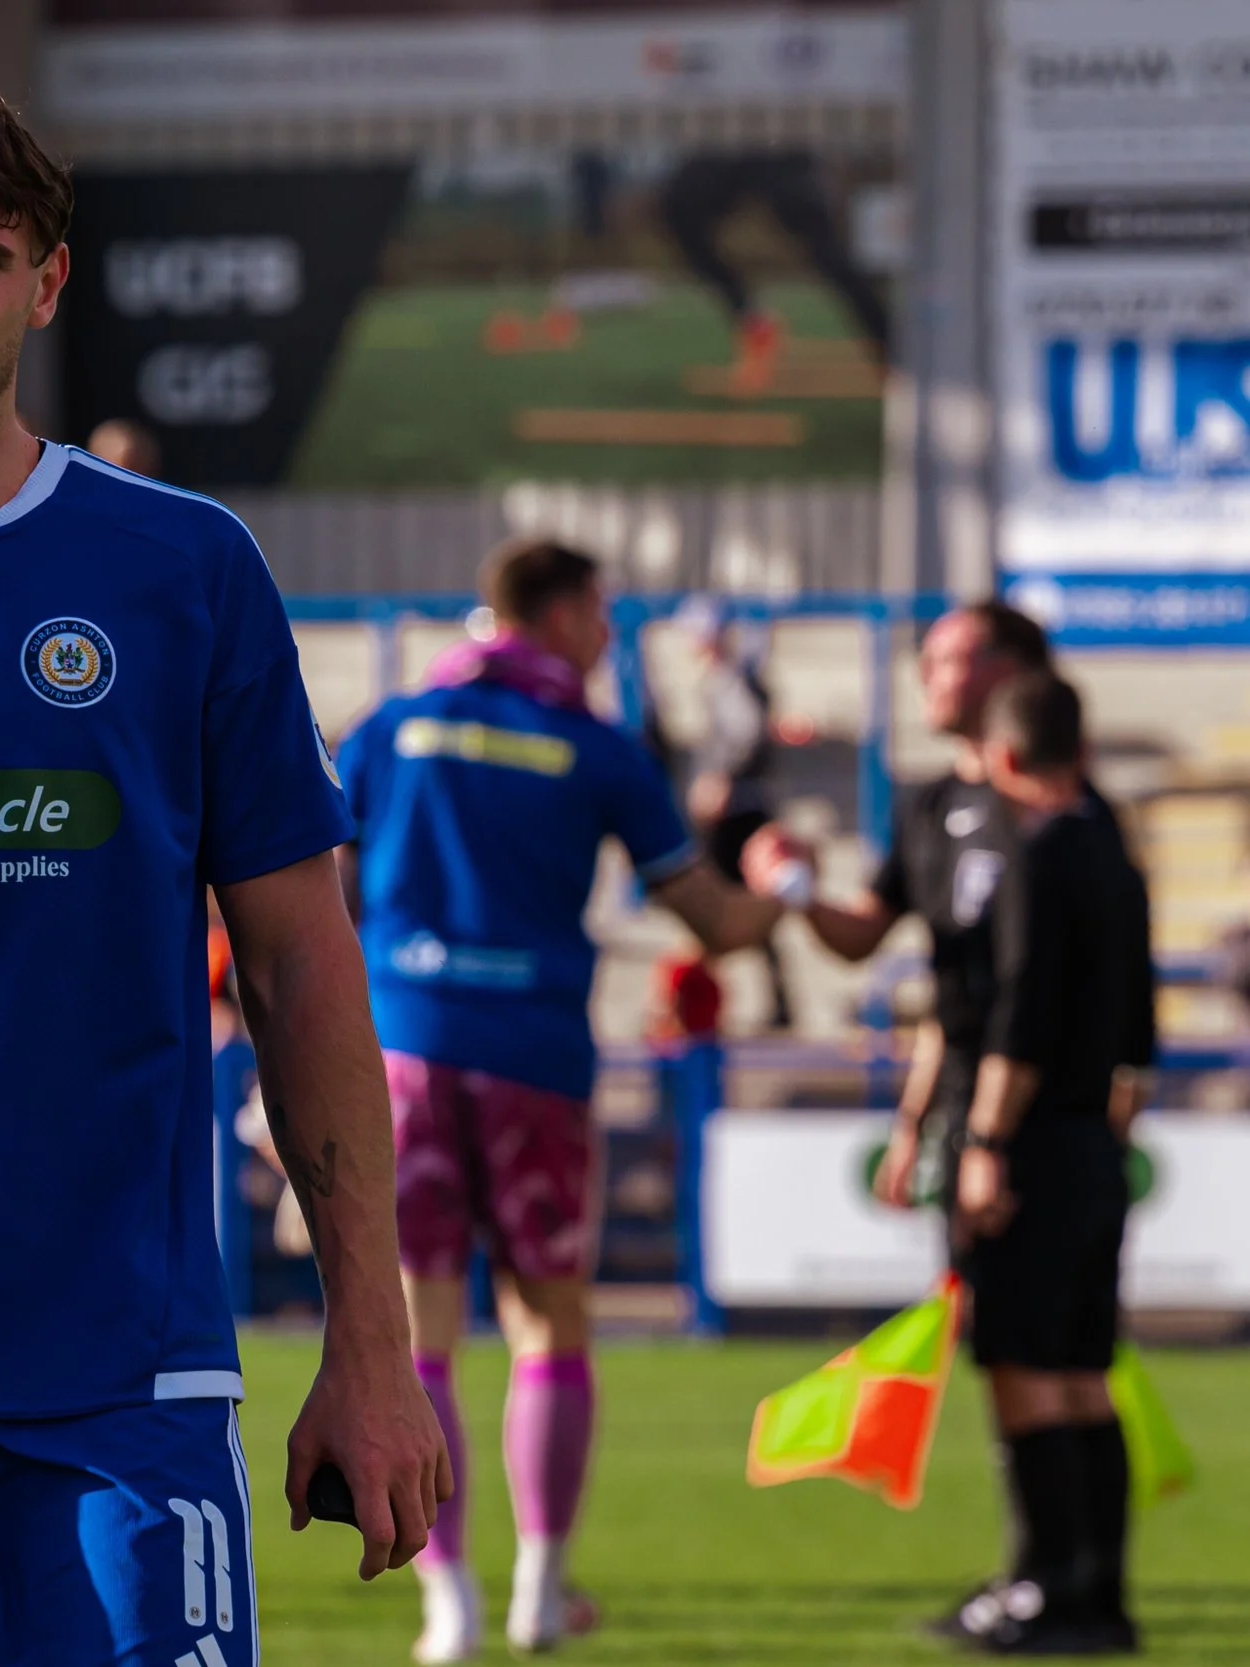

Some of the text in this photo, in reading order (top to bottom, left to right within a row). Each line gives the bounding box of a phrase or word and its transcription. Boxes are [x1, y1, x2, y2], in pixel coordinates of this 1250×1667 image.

[30, 623, 110, 656] CURZON ASHTON
[32, 672, 109, 701] FOOTBALL CLUB
[167, 1497, 234, 1632] 11
